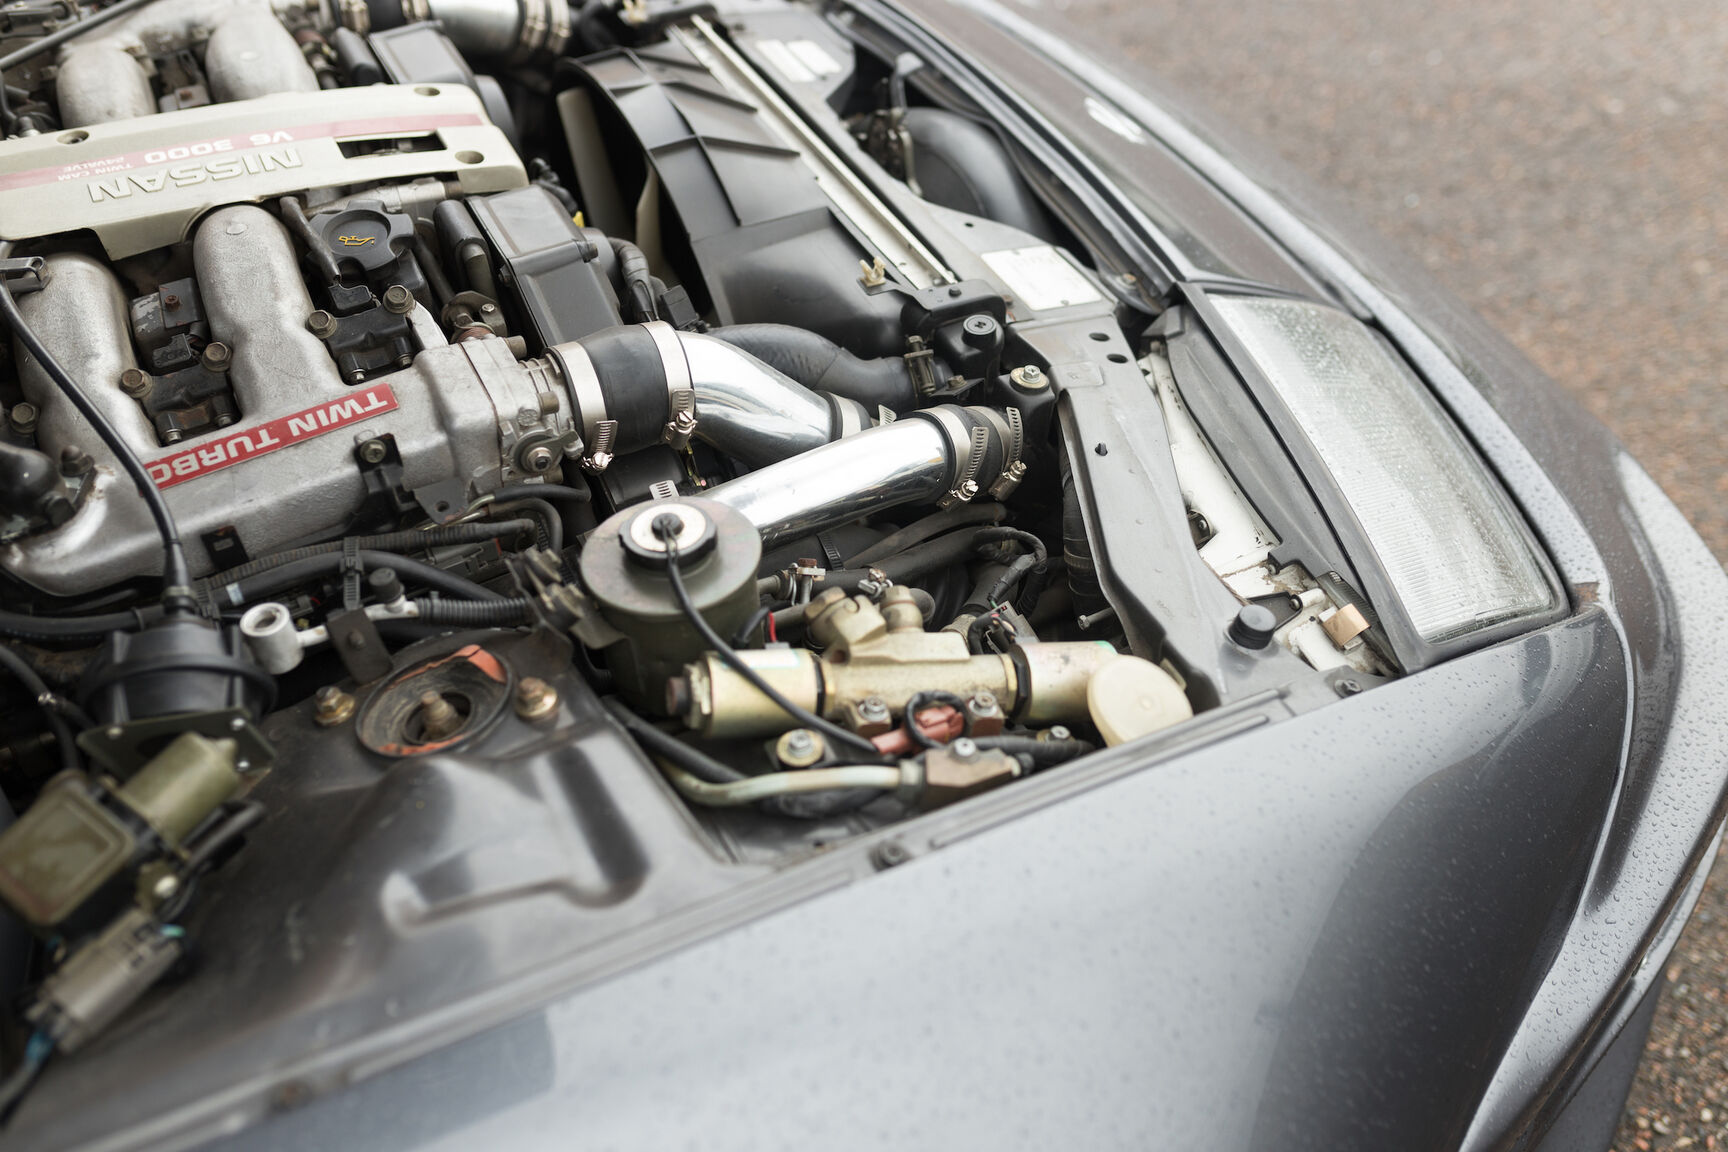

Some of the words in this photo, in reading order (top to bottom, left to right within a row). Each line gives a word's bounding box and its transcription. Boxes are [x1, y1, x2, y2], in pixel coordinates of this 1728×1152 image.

[249, 130, 294, 146] V6
[144, 139, 235, 164] 3000
[57, 169, 91, 181] CAM
[87, 148, 303, 203] NISSAN
[95, 162, 133, 176] TWIN
[287, 391, 387, 437] TWIN
[148, 428, 280, 484] TURBO
